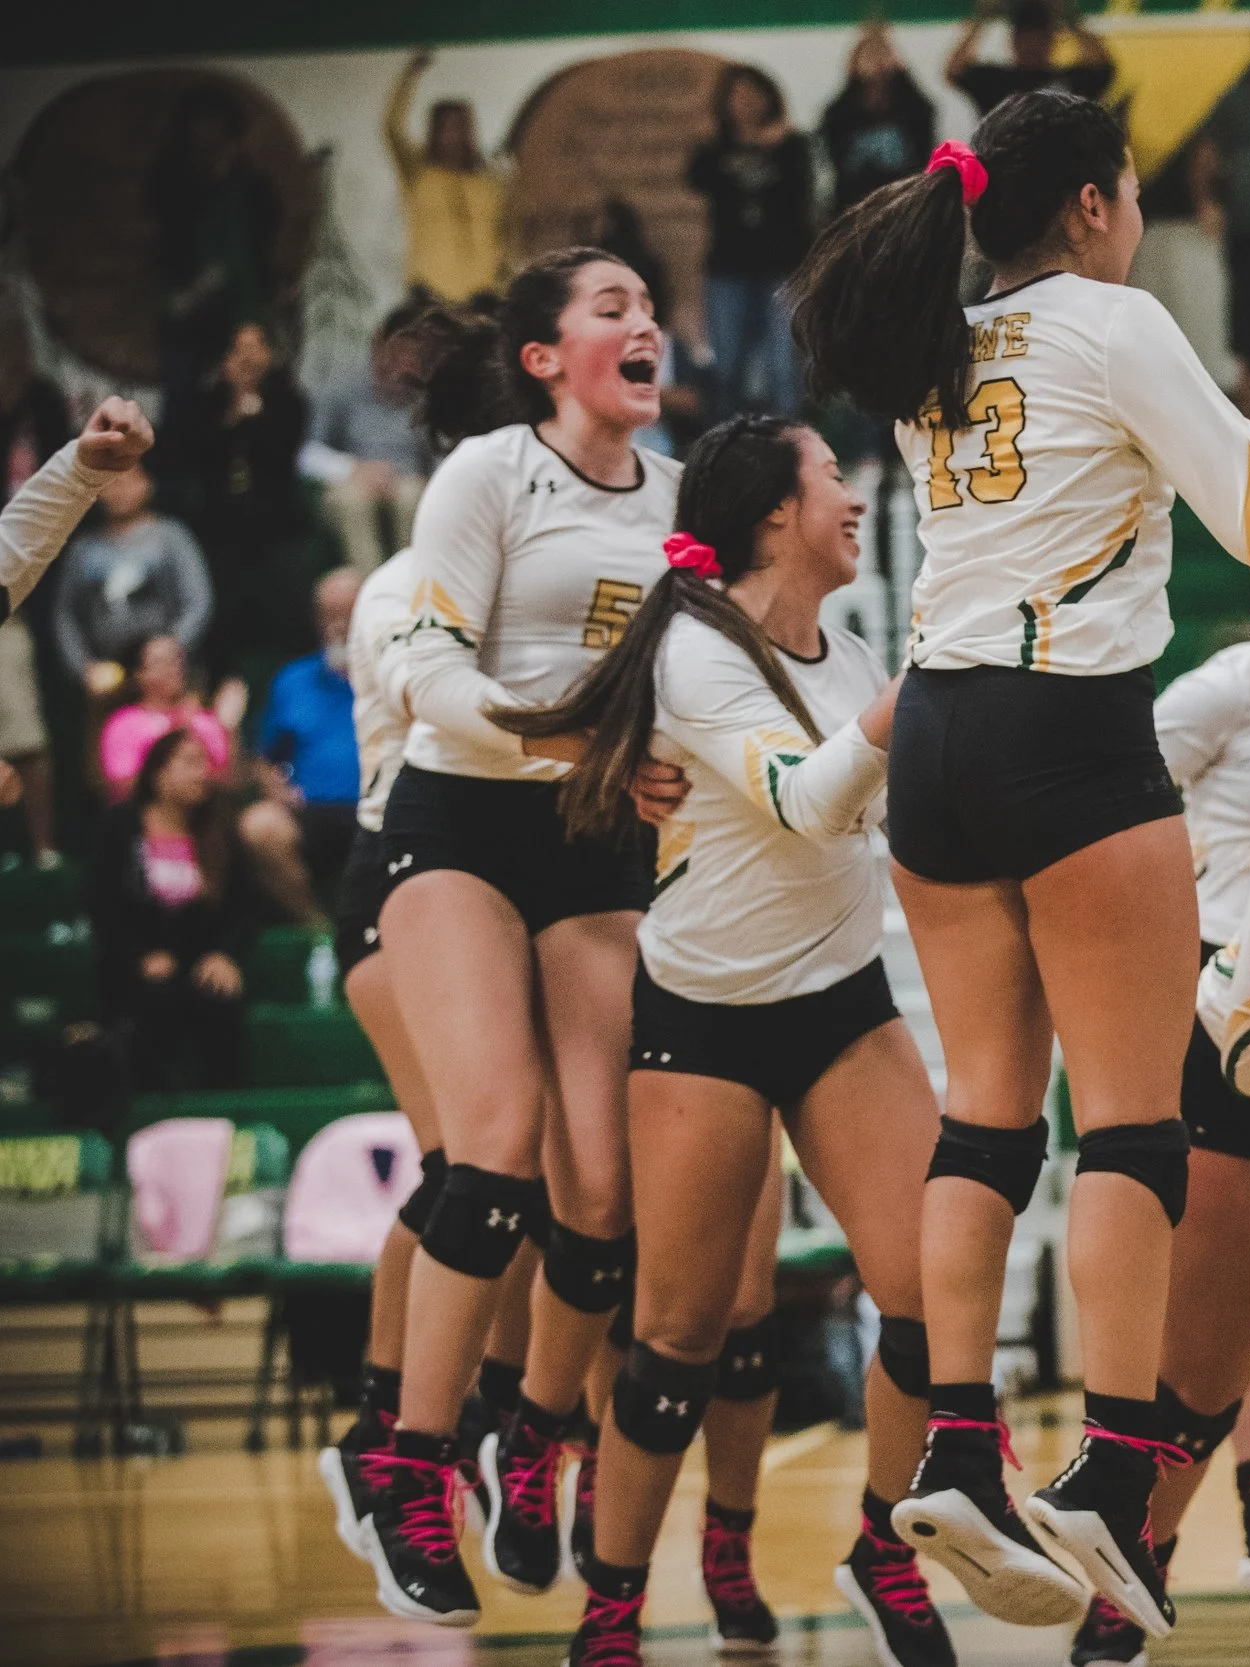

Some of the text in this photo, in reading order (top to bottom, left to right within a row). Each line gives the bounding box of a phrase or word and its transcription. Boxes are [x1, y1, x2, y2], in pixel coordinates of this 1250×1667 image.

[967, 312, 1032, 363] WE
[919, 376, 1027, 511] 13
[583, 578, 643, 649] 5
